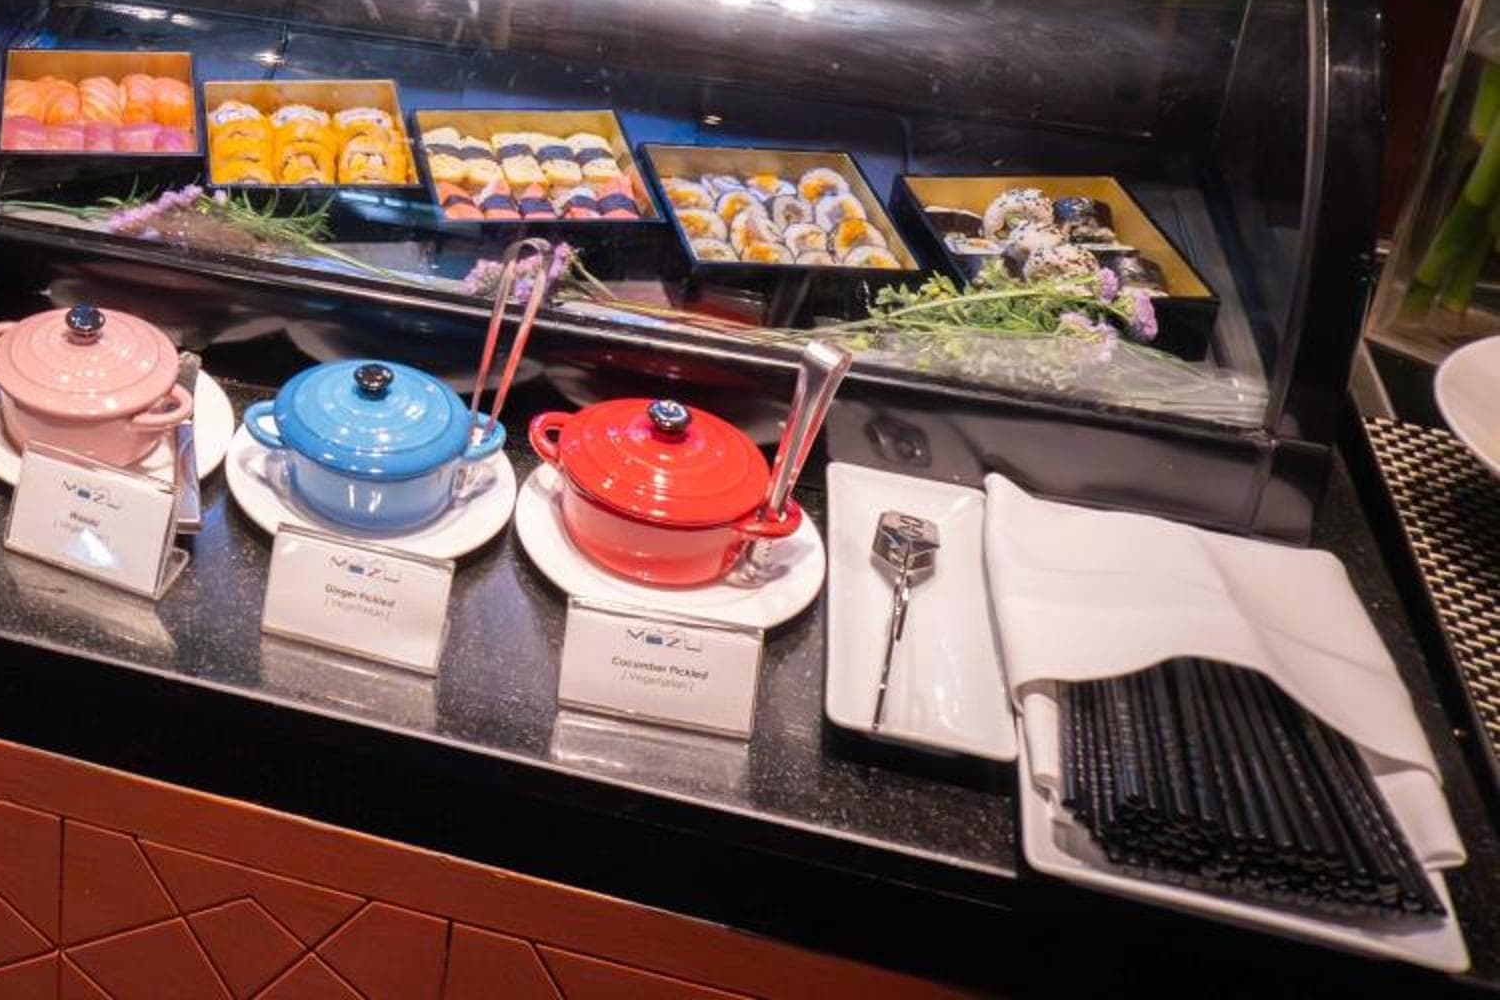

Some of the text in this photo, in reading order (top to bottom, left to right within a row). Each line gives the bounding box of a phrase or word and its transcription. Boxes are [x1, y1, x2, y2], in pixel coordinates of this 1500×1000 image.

[325, 583, 396, 607] Ginger Pickled
[611, 655, 709, 680] Cucumber Pickled
